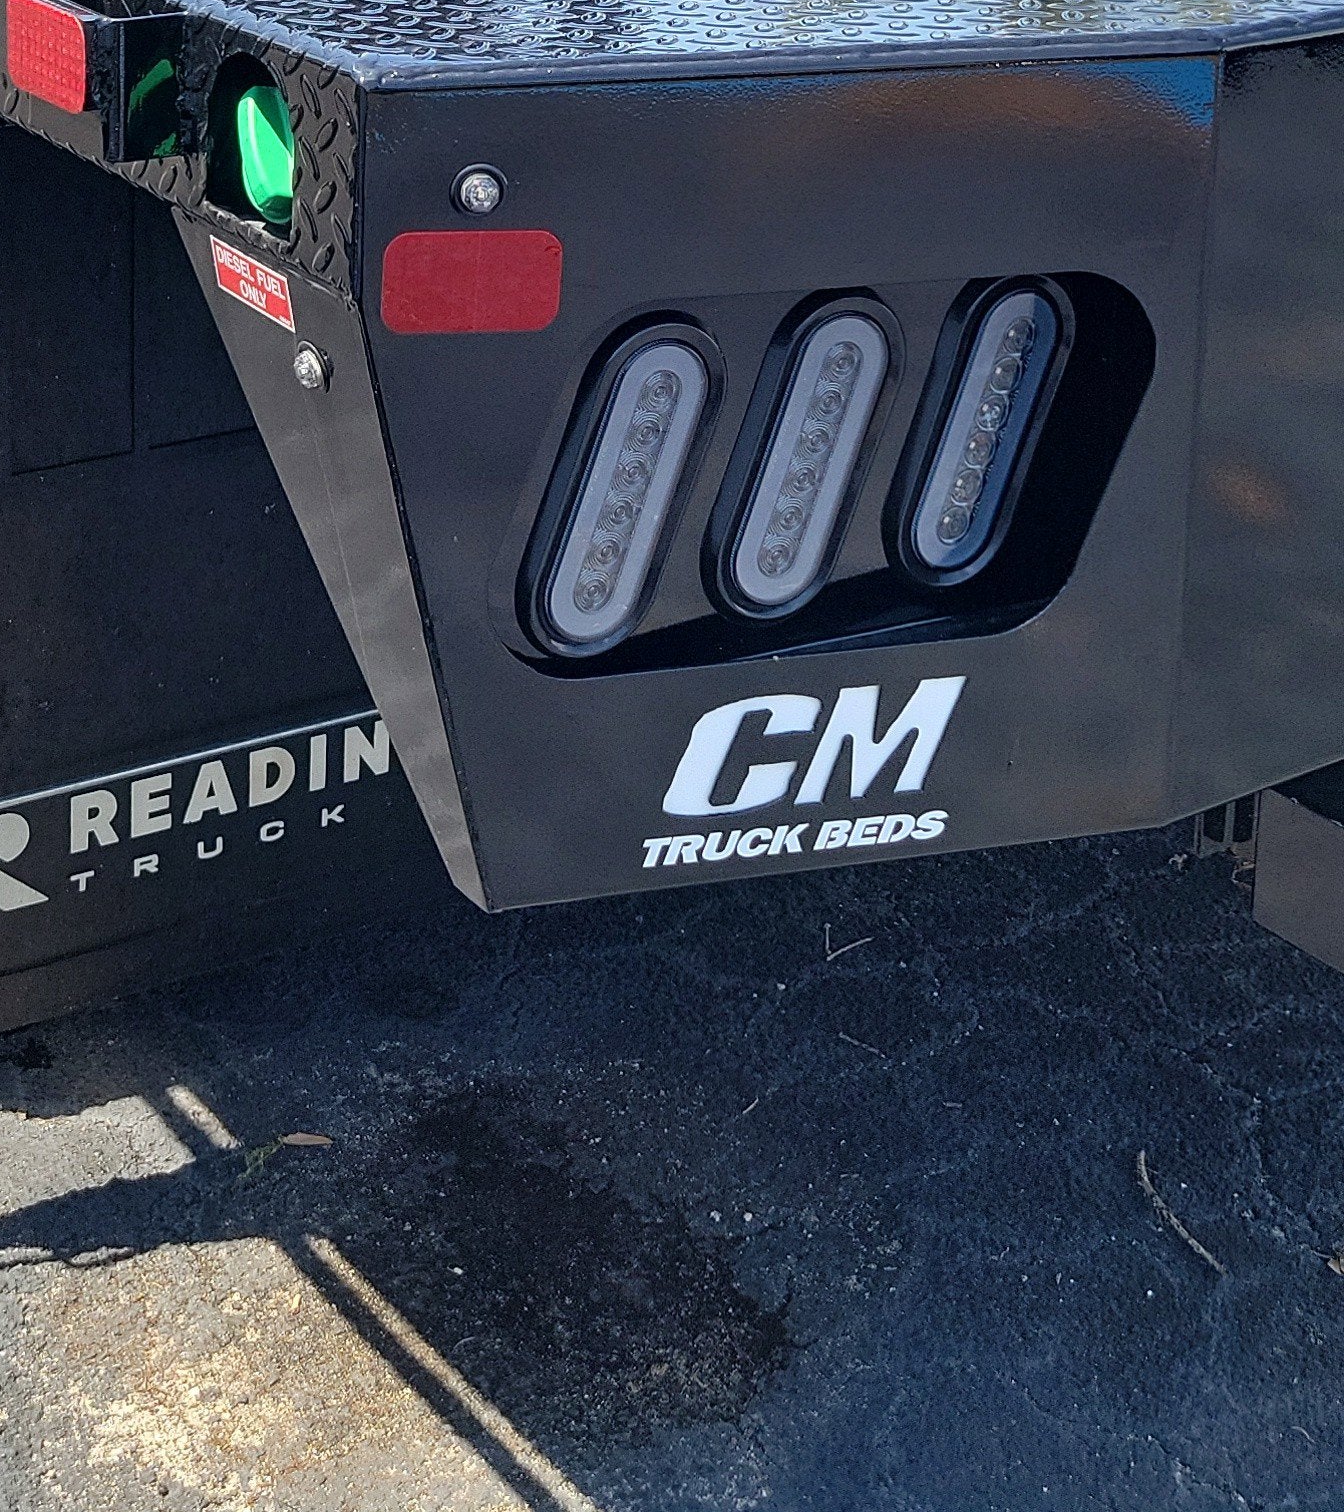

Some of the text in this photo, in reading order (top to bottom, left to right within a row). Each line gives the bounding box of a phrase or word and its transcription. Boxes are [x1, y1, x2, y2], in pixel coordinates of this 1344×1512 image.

[215, 244, 287, 301] DIESEL FUEL
[239, 279, 267, 310] ONLY
[662, 675, 967, 817] CM
[69, 719, 391, 854] READIN
[69, 804, 346, 892] TRUCK
[641, 809, 950, 869] TRUCK BEDS
